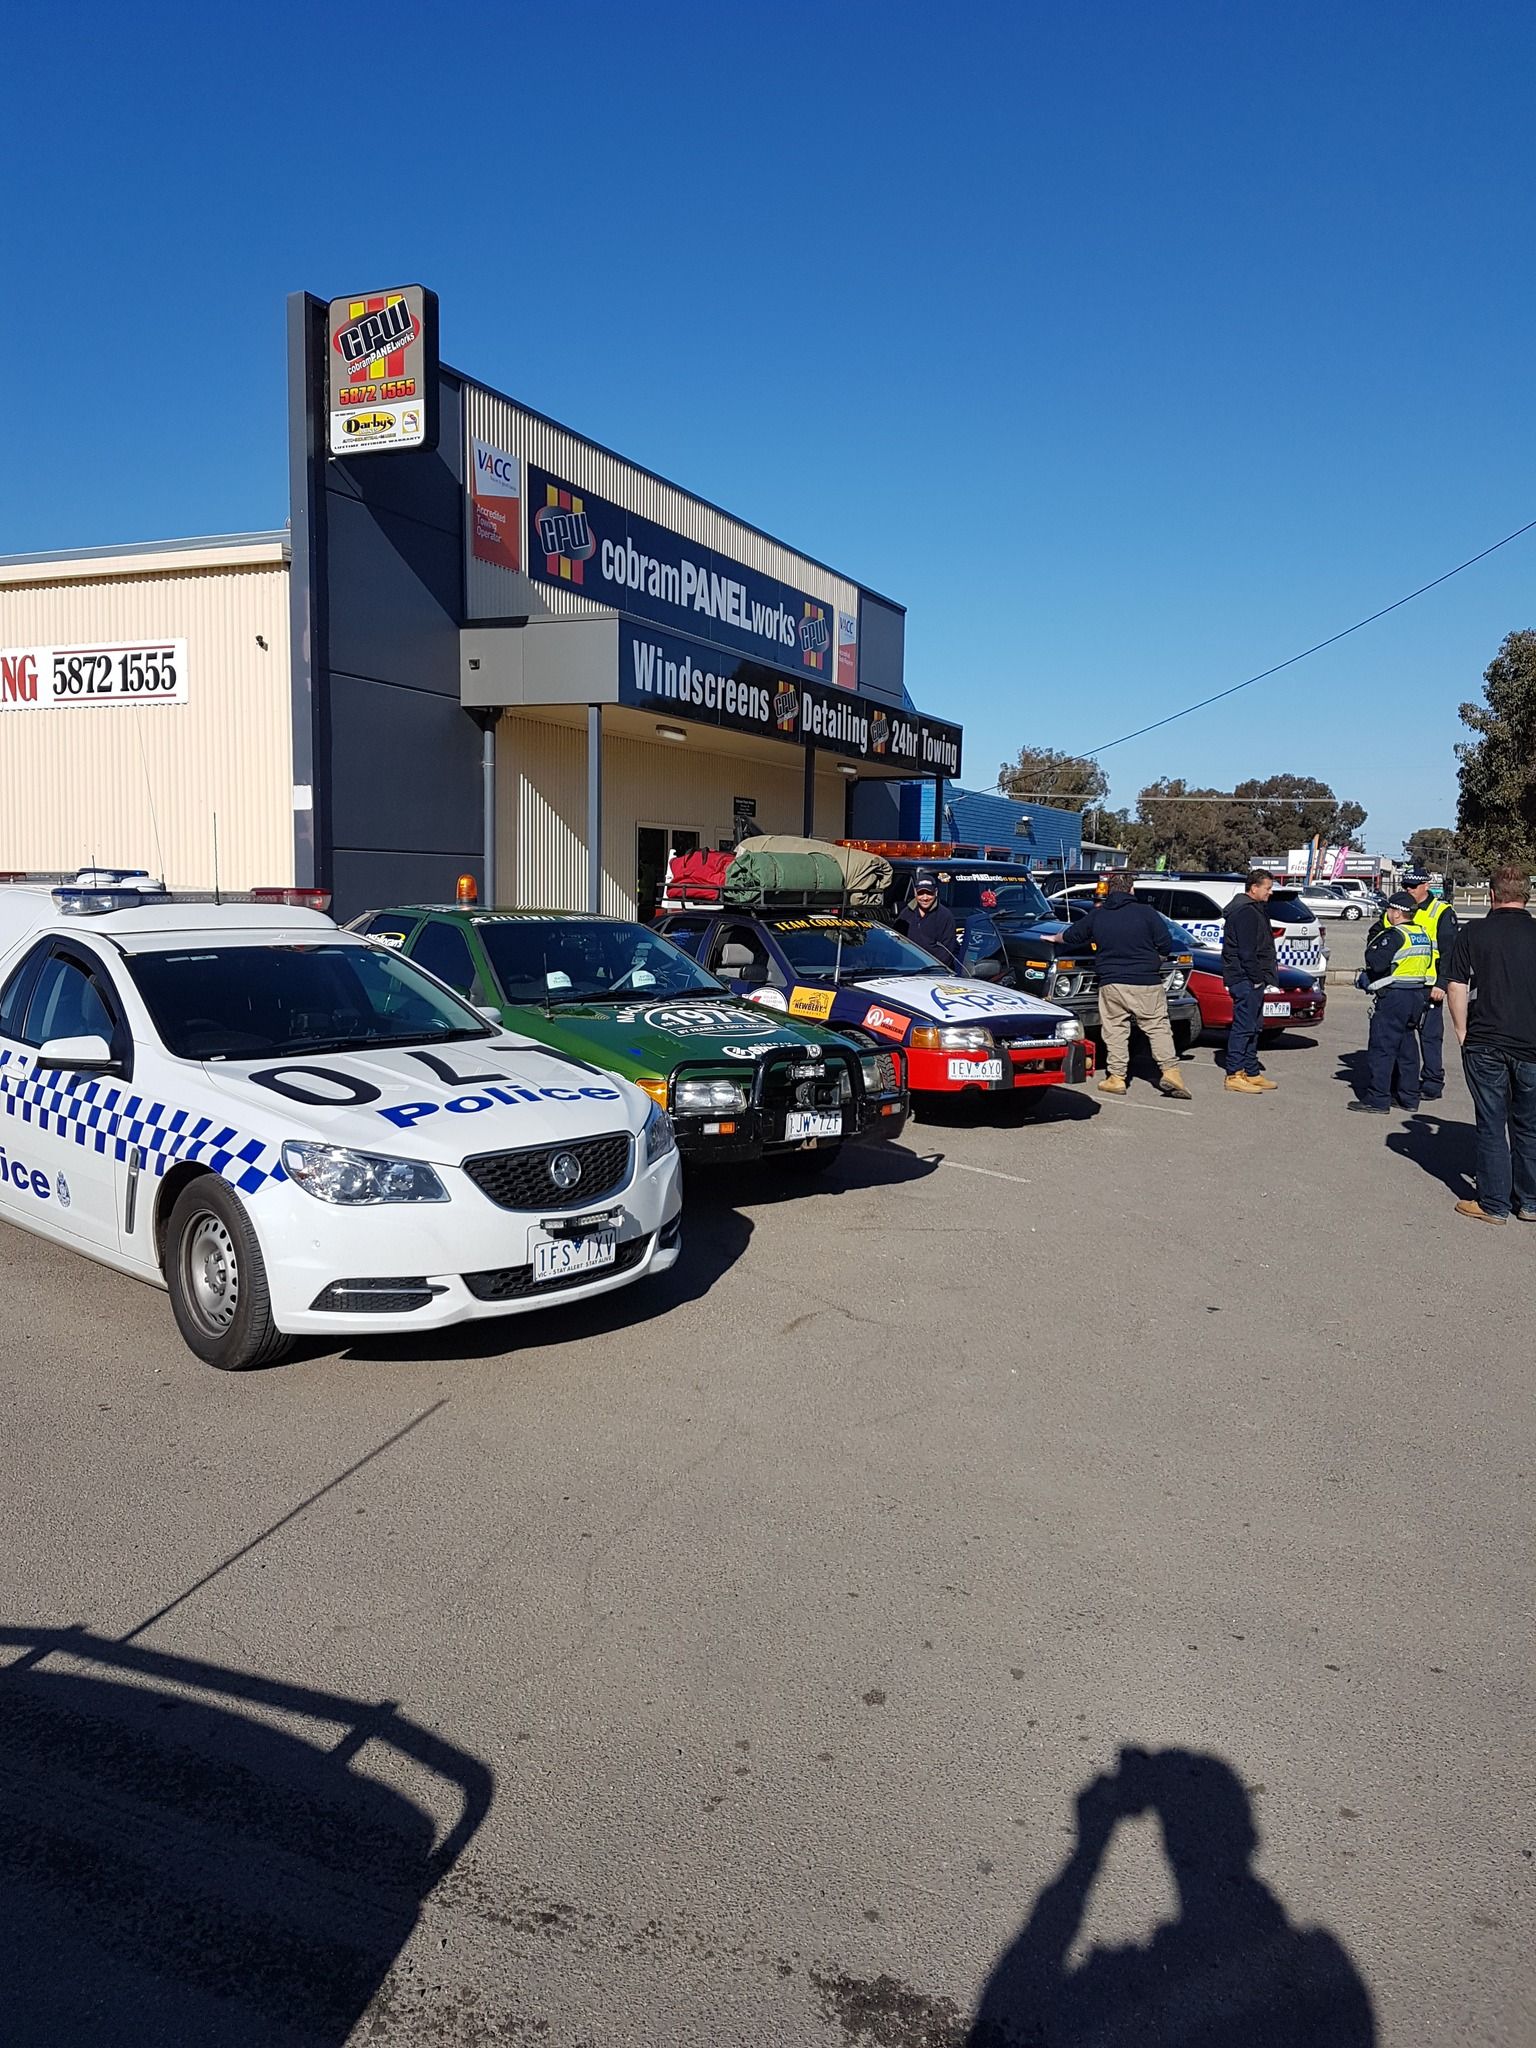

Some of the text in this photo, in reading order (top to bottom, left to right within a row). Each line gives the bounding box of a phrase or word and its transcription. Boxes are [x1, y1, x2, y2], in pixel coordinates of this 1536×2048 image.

[339, 378, 415, 405] 5872 1555
[477, 448, 512, 482] VACC
[52, 655, 113, 695] 5872
[119, 651, 177, 693] 1555
[632, 639, 770, 722] Windscreens
[802, 692, 868, 753] Detailing
[892, 720, 958, 774] 24hr Towing
[774, 920, 811, 931] TEAM
[375, 1084, 621, 1129] Police
